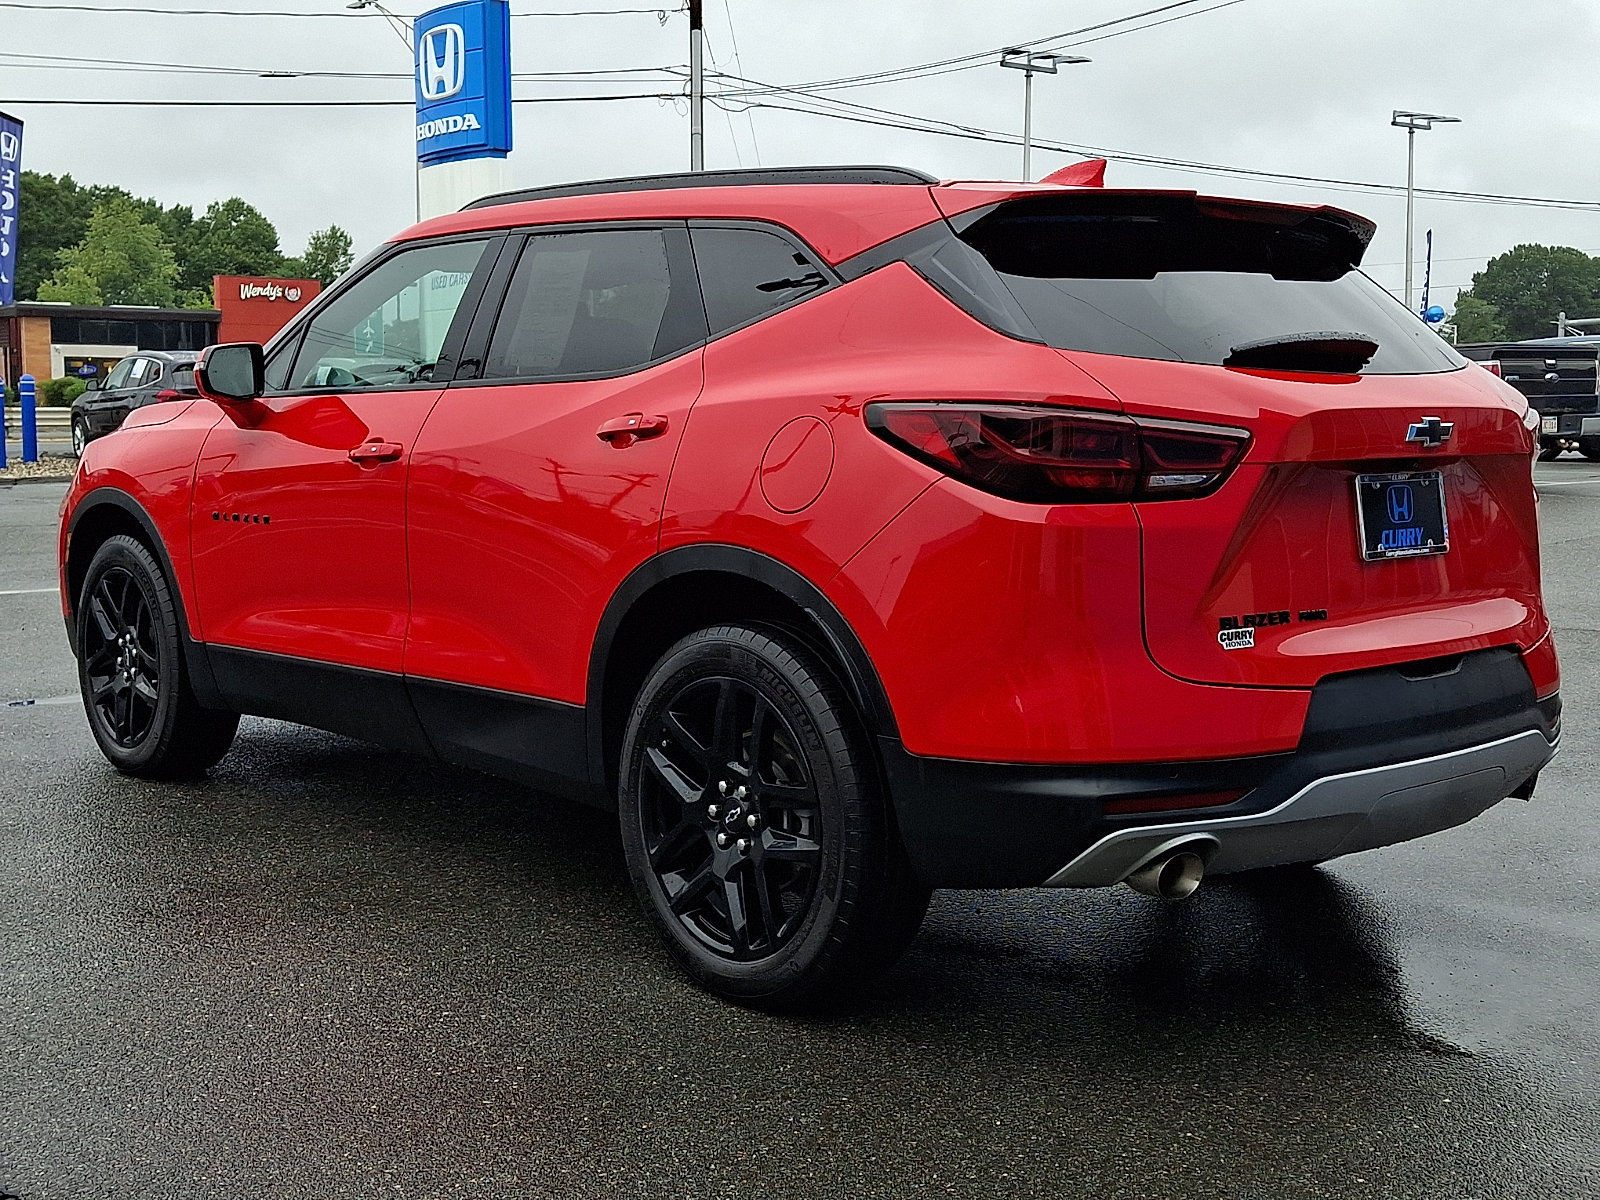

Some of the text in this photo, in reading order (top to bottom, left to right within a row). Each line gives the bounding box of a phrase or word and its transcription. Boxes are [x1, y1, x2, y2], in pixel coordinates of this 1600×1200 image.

[416, 113, 481, 141] HONDA
[240, 281, 283, 301] Wendy's
[431, 275, 447, 290] USED
[212, 510, 271, 525] BLAZER
[1382, 527, 1424, 549] CURRY
[1219, 609, 1291, 630] BLAZER
[1220, 630, 1253, 643] CURRY
[1225, 639, 1253, 648] HONDA
[759, 666, 825, 752] MICHELIN
